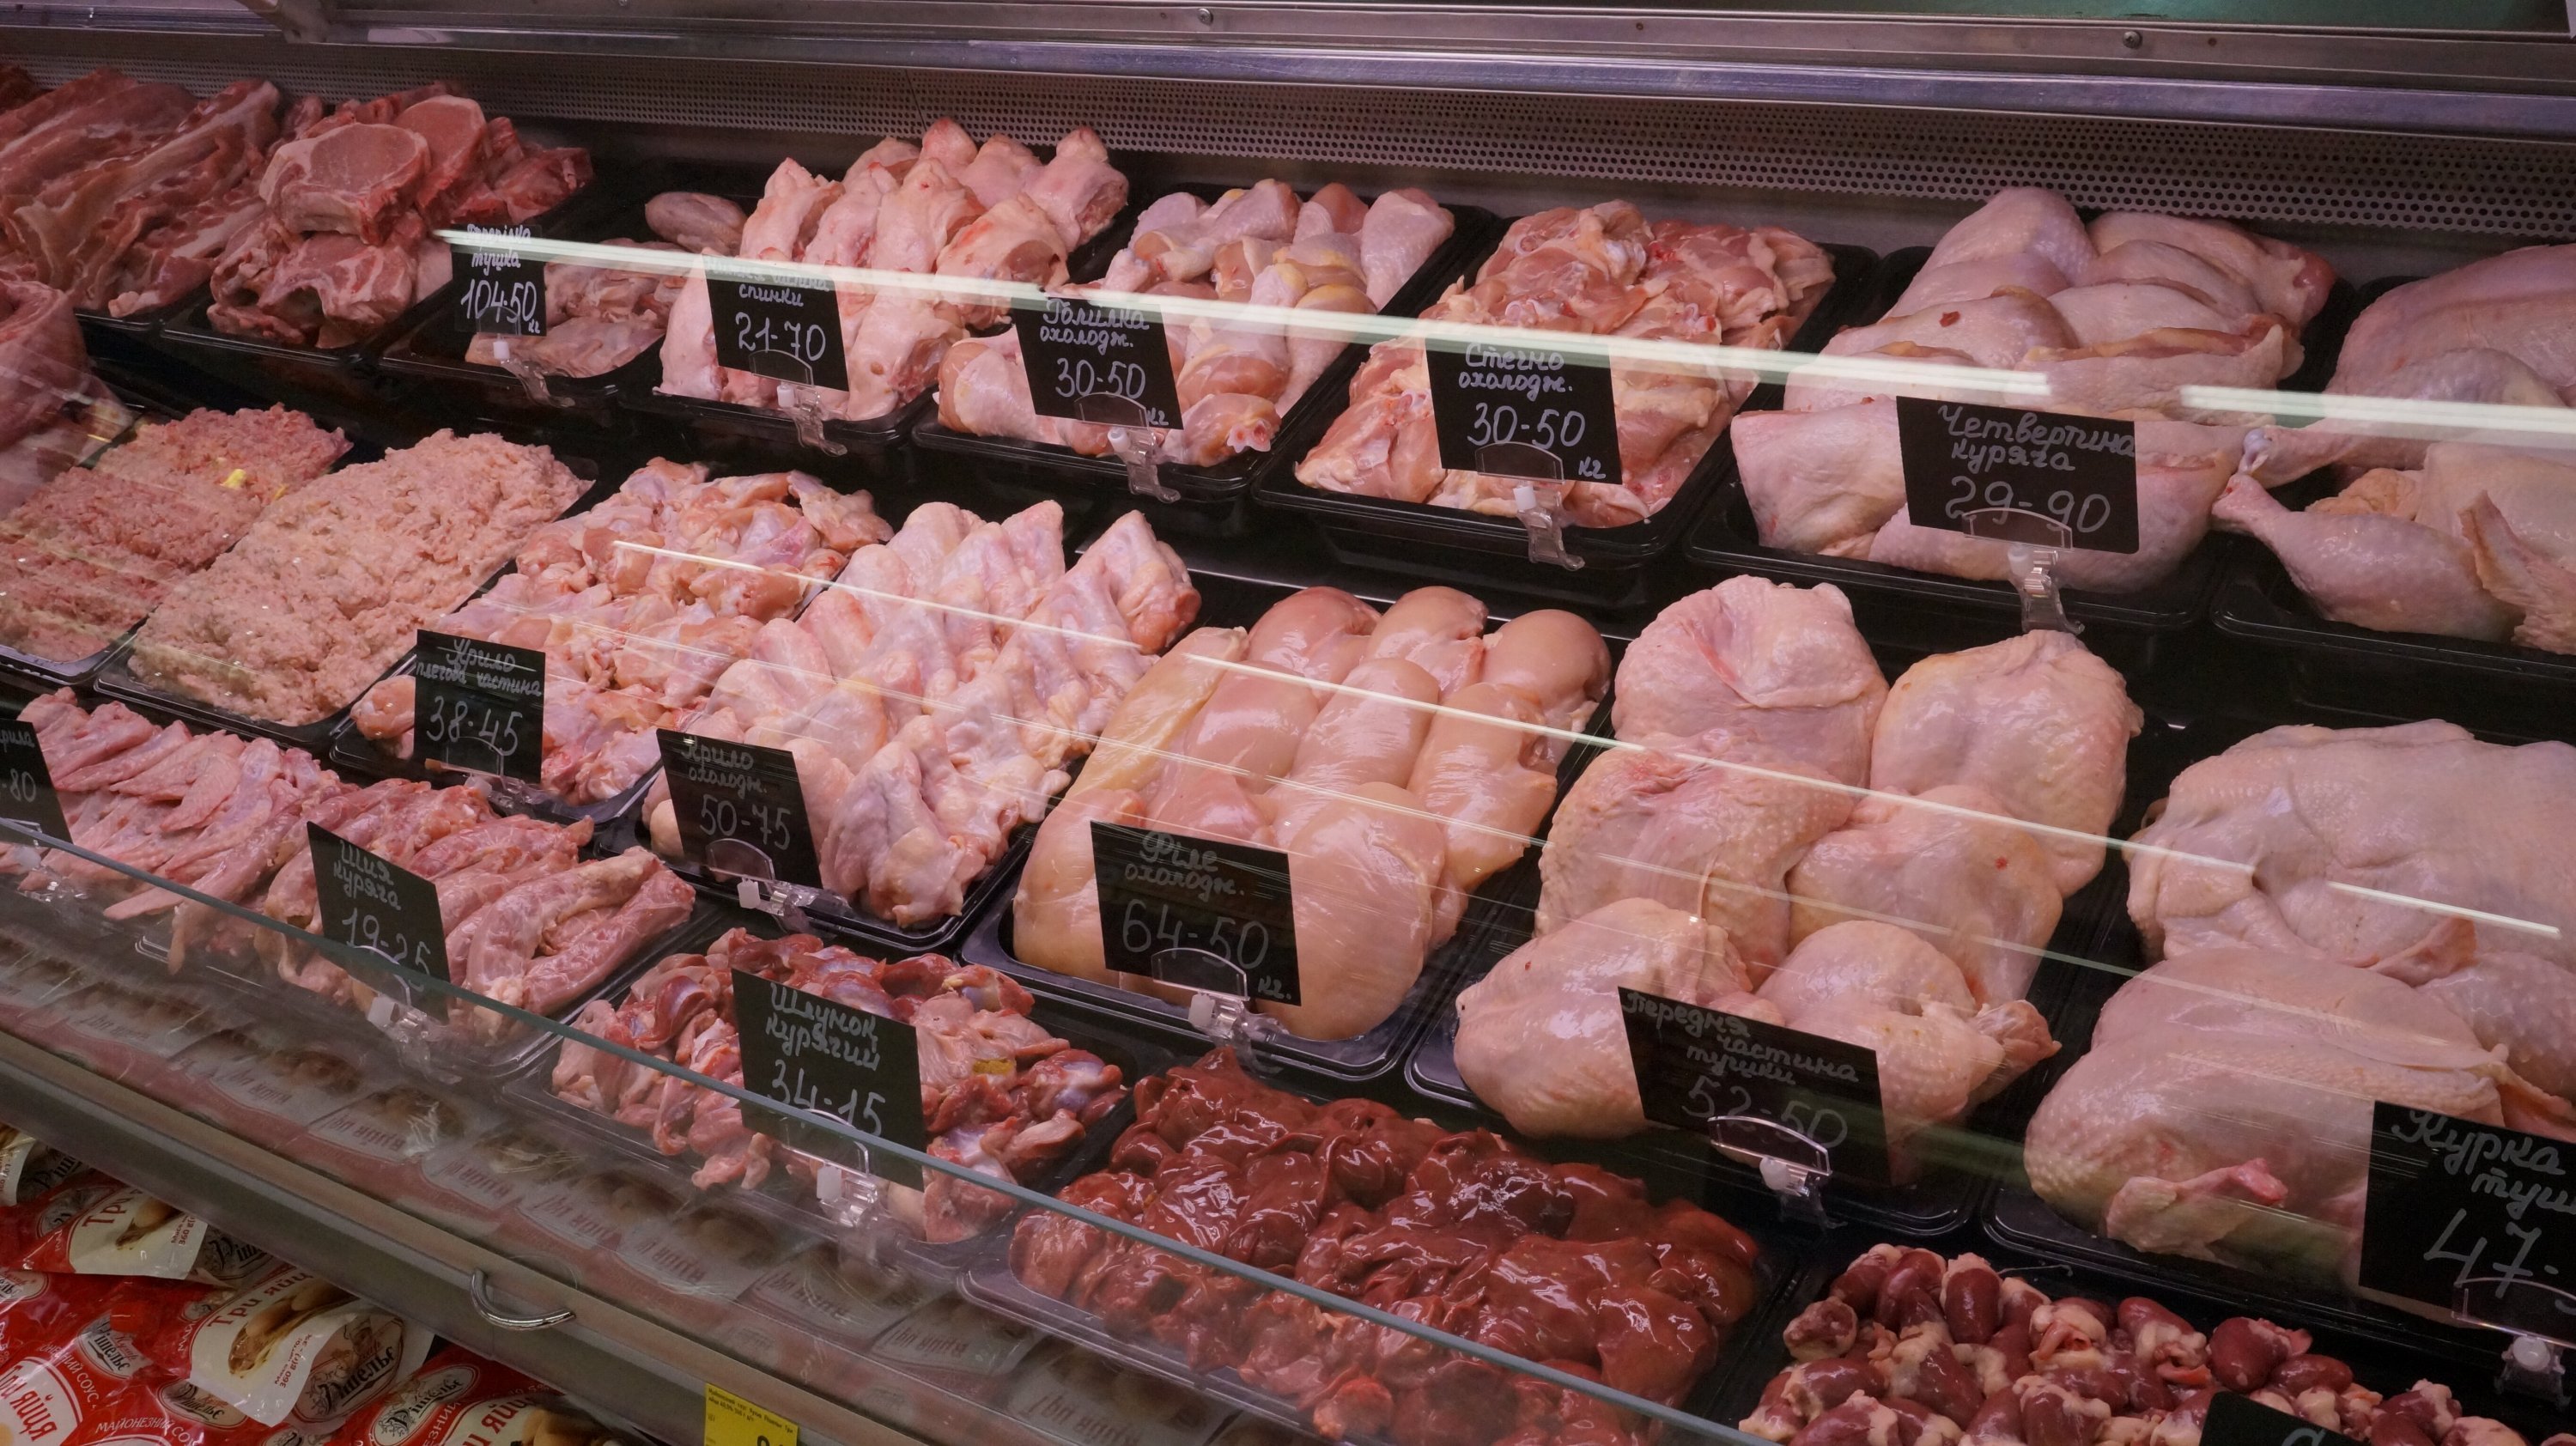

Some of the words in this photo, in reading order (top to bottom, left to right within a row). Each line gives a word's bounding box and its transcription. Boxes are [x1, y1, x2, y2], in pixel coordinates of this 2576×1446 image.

[471, 246, 521, 276] тушка
[738, 283, 804, 307] спинки
[735, 311, 826, 362] 21-70
[1040, 325, 1133, 355] охолодж.
[1465, 343, 1564, 370] Стегно
[1055, 357, 1146, 399] 30-50
[1459, 372, 1573, 402] охолодж.
[1467, 402, 1586, 450] 30-50
[1937, 404, 2136, 458] Четвертина
[1945, 476, 2111, 533] 29-90
[476, 671, 543, 696] частина
[689, 766, 768, 799] охолодж.
[700, 793, 791, 851] 50-75
[339, 839, 395, 886] Шия
[1139, 830, 1218, 872] Філе
[1125, 863, 1244, 902] охолодж.
[1122, 898, 1269, 969] 64-50
[770, 982, 879, 1042] Шлунок
[1717, 1034, 1860, 1082] частина
[768, 1059, 886, 1136] 34-15
[1681, 1075, 1848, 1148] 52-50
[2391, 1110, 2567, 1175] Курка
[206, 1297, 263, 1328] Три
[279, 1370, 292, 1388] 360
[9, 1390, 58, 1443] яйця
